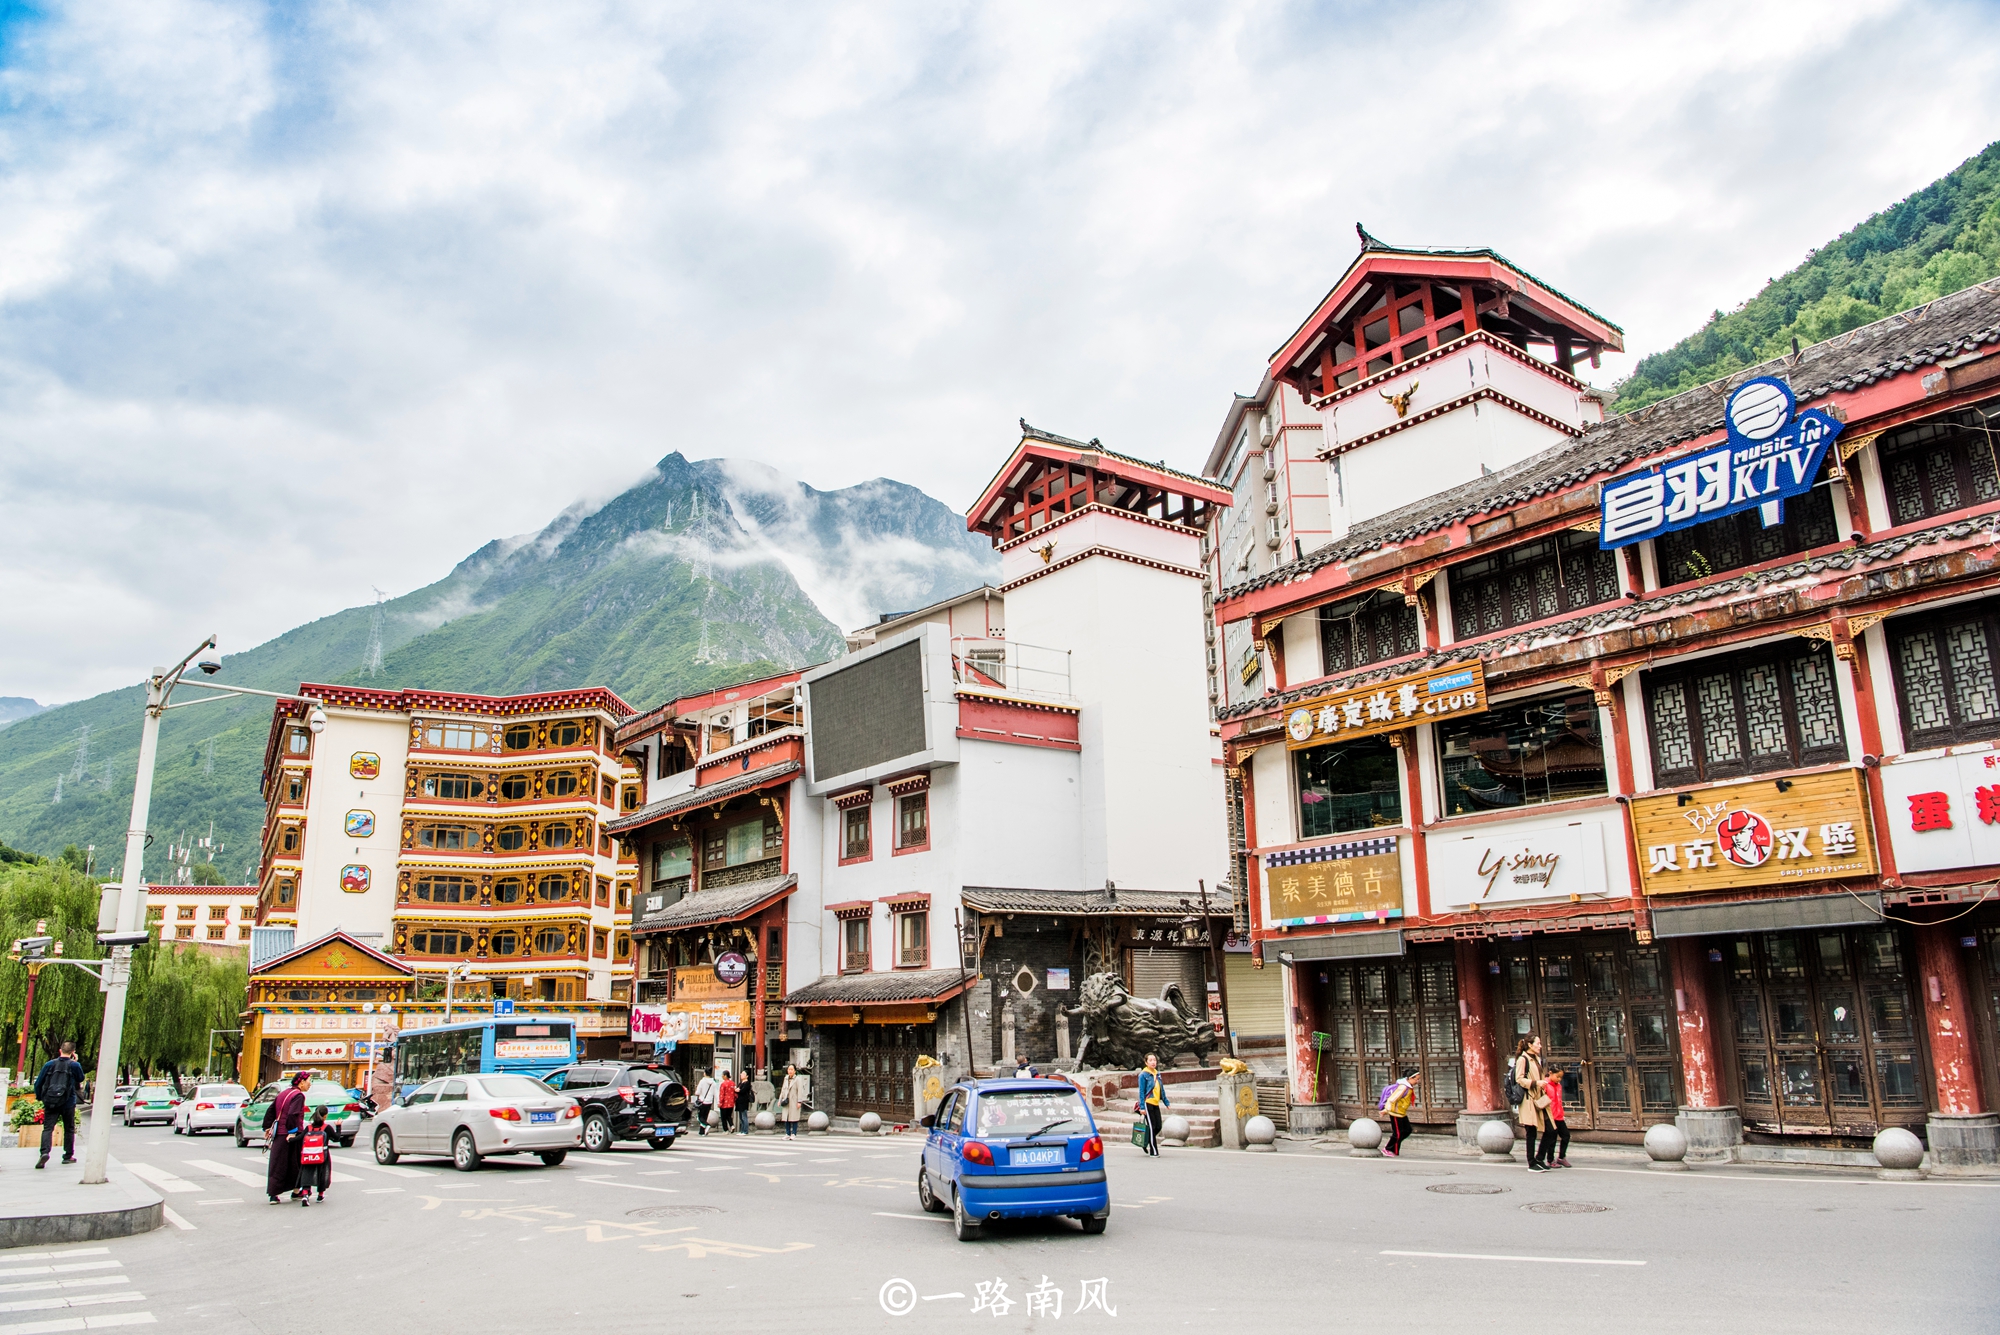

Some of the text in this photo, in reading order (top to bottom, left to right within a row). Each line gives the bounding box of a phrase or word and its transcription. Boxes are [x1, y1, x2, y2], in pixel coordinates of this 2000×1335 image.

[1730, 442, 1821, 504] KTV
[1317, 683, 1421, 734] 康定故事
[1422, 691, 1478, 715] CLUB
[1647, 821, 1858, 874] 贝克 汉堡
[1281, 867, 1384, 903] 索美德吉
[1132, 929, 1210, 942] 康源牦肉
[685, 973, 718, 985] HIMALAYA
[303, 1154, 321, 1162] FILA
